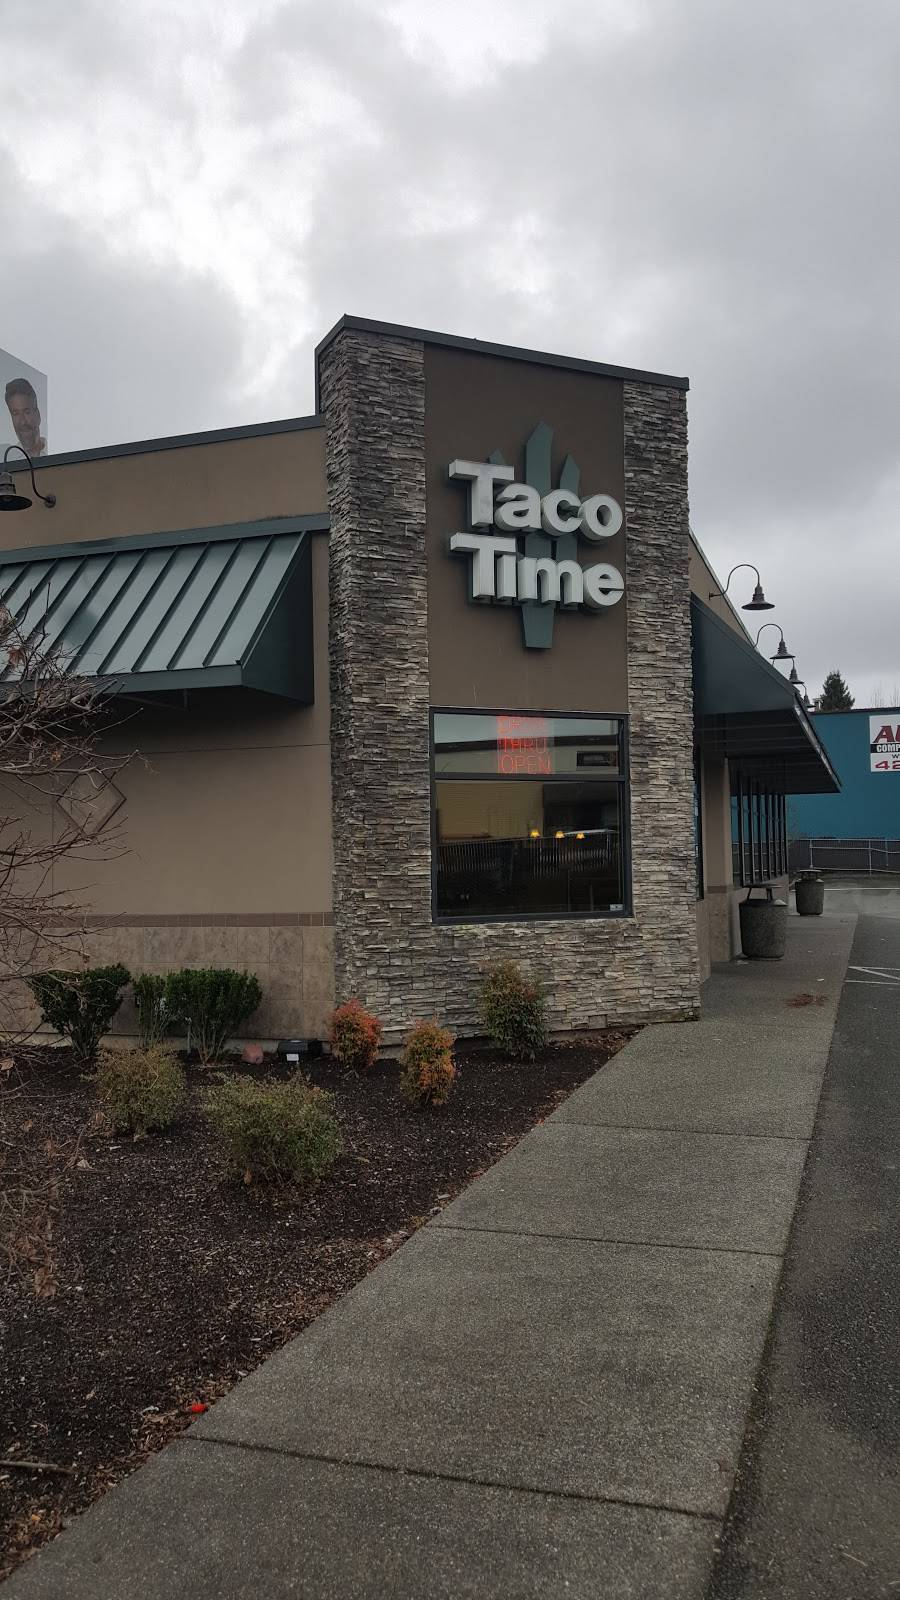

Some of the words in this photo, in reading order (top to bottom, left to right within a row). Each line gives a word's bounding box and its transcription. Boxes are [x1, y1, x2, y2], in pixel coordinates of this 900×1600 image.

[449, 459, 623, 540] Taco
[450, 532, 625, 609] Time
[502, 754, 551, 774] OPEN
